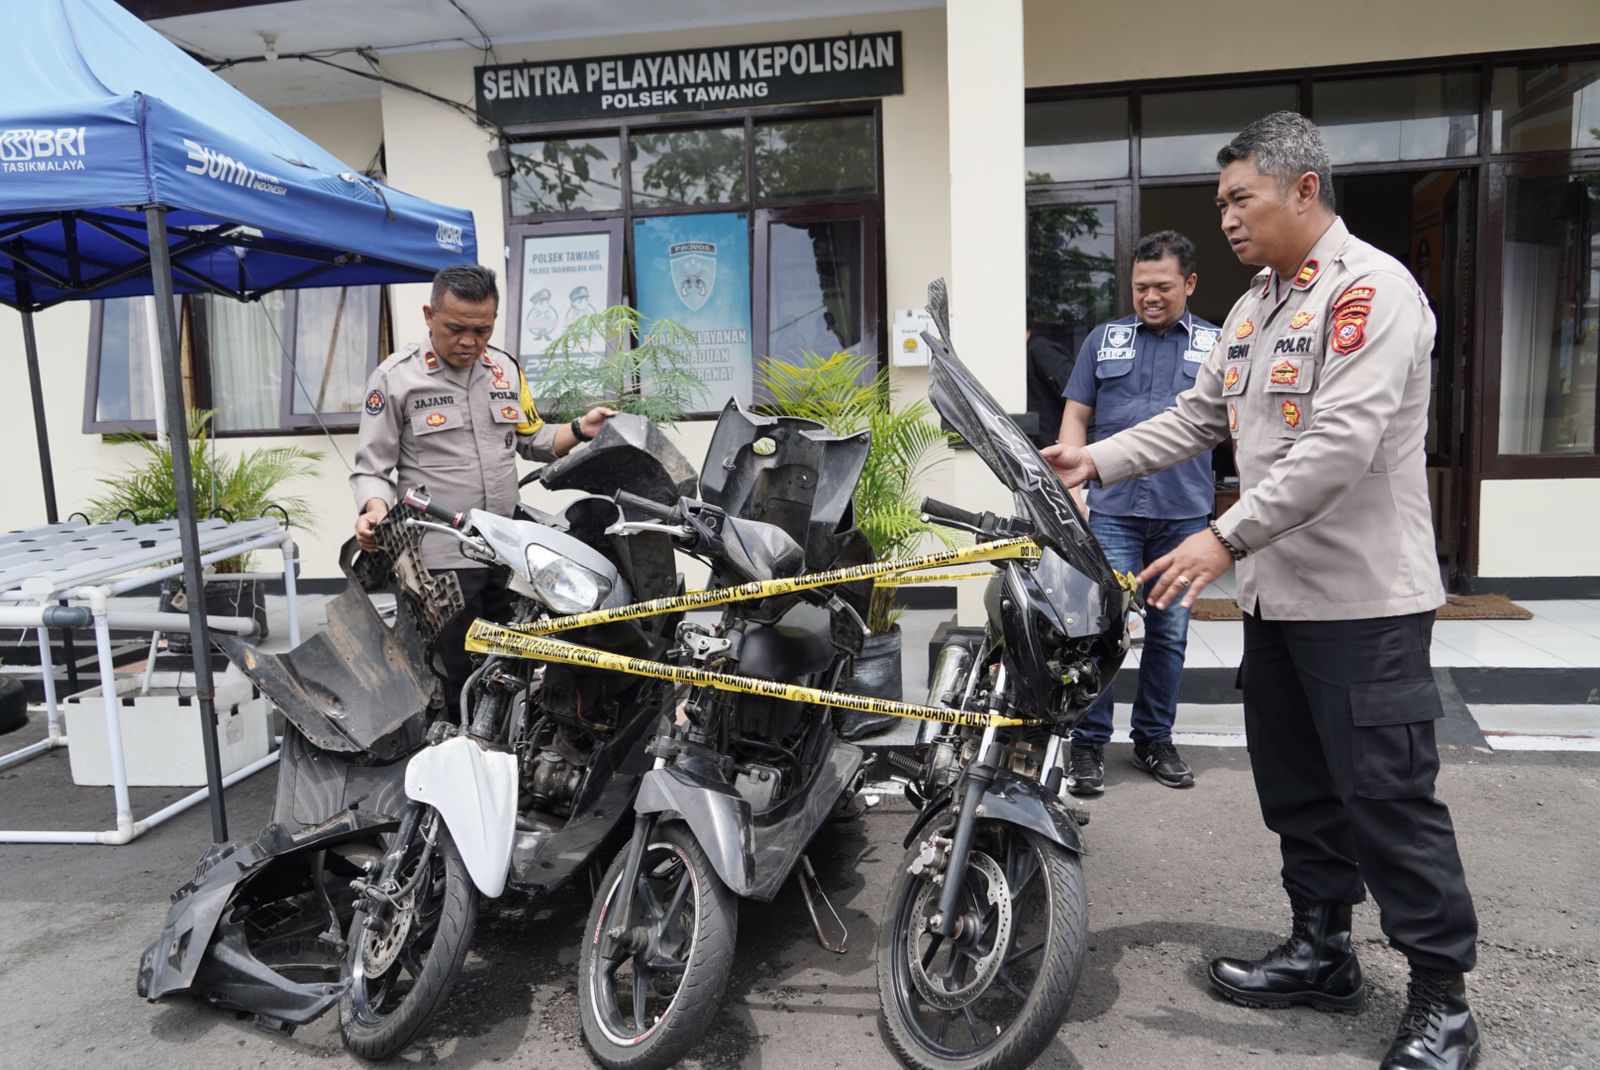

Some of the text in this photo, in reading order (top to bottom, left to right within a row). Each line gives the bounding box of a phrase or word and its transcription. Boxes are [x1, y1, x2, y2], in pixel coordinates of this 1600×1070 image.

[482, 36, 895, 101] SENTRA PELAYANAN KEPOLISIAN
[601, 81, 769, 111] POLSEK TAWANG
[32, 126, 87, 158] BRI
[1, 160, 86, 173] TASIKMALAYA
[253, 182, 288, 196] INDONESIA
[532, 250, 600, 264] POLSEK TAWANG
[1273, 336, 1312, 353] POLRI
[414, 395, 454, 410] JAJANG
[489, 391, 519, 401] POLRI
[732, 581, 764, 598] POLISI
[570, 647, 602, 664] POLISI
[628, 659, 673, 678] DILARANG
[754, 679, 788, 696] POLISI
[819, 690, 870, 710] DILARANG
[958, 711, 992, 727] POLISI
